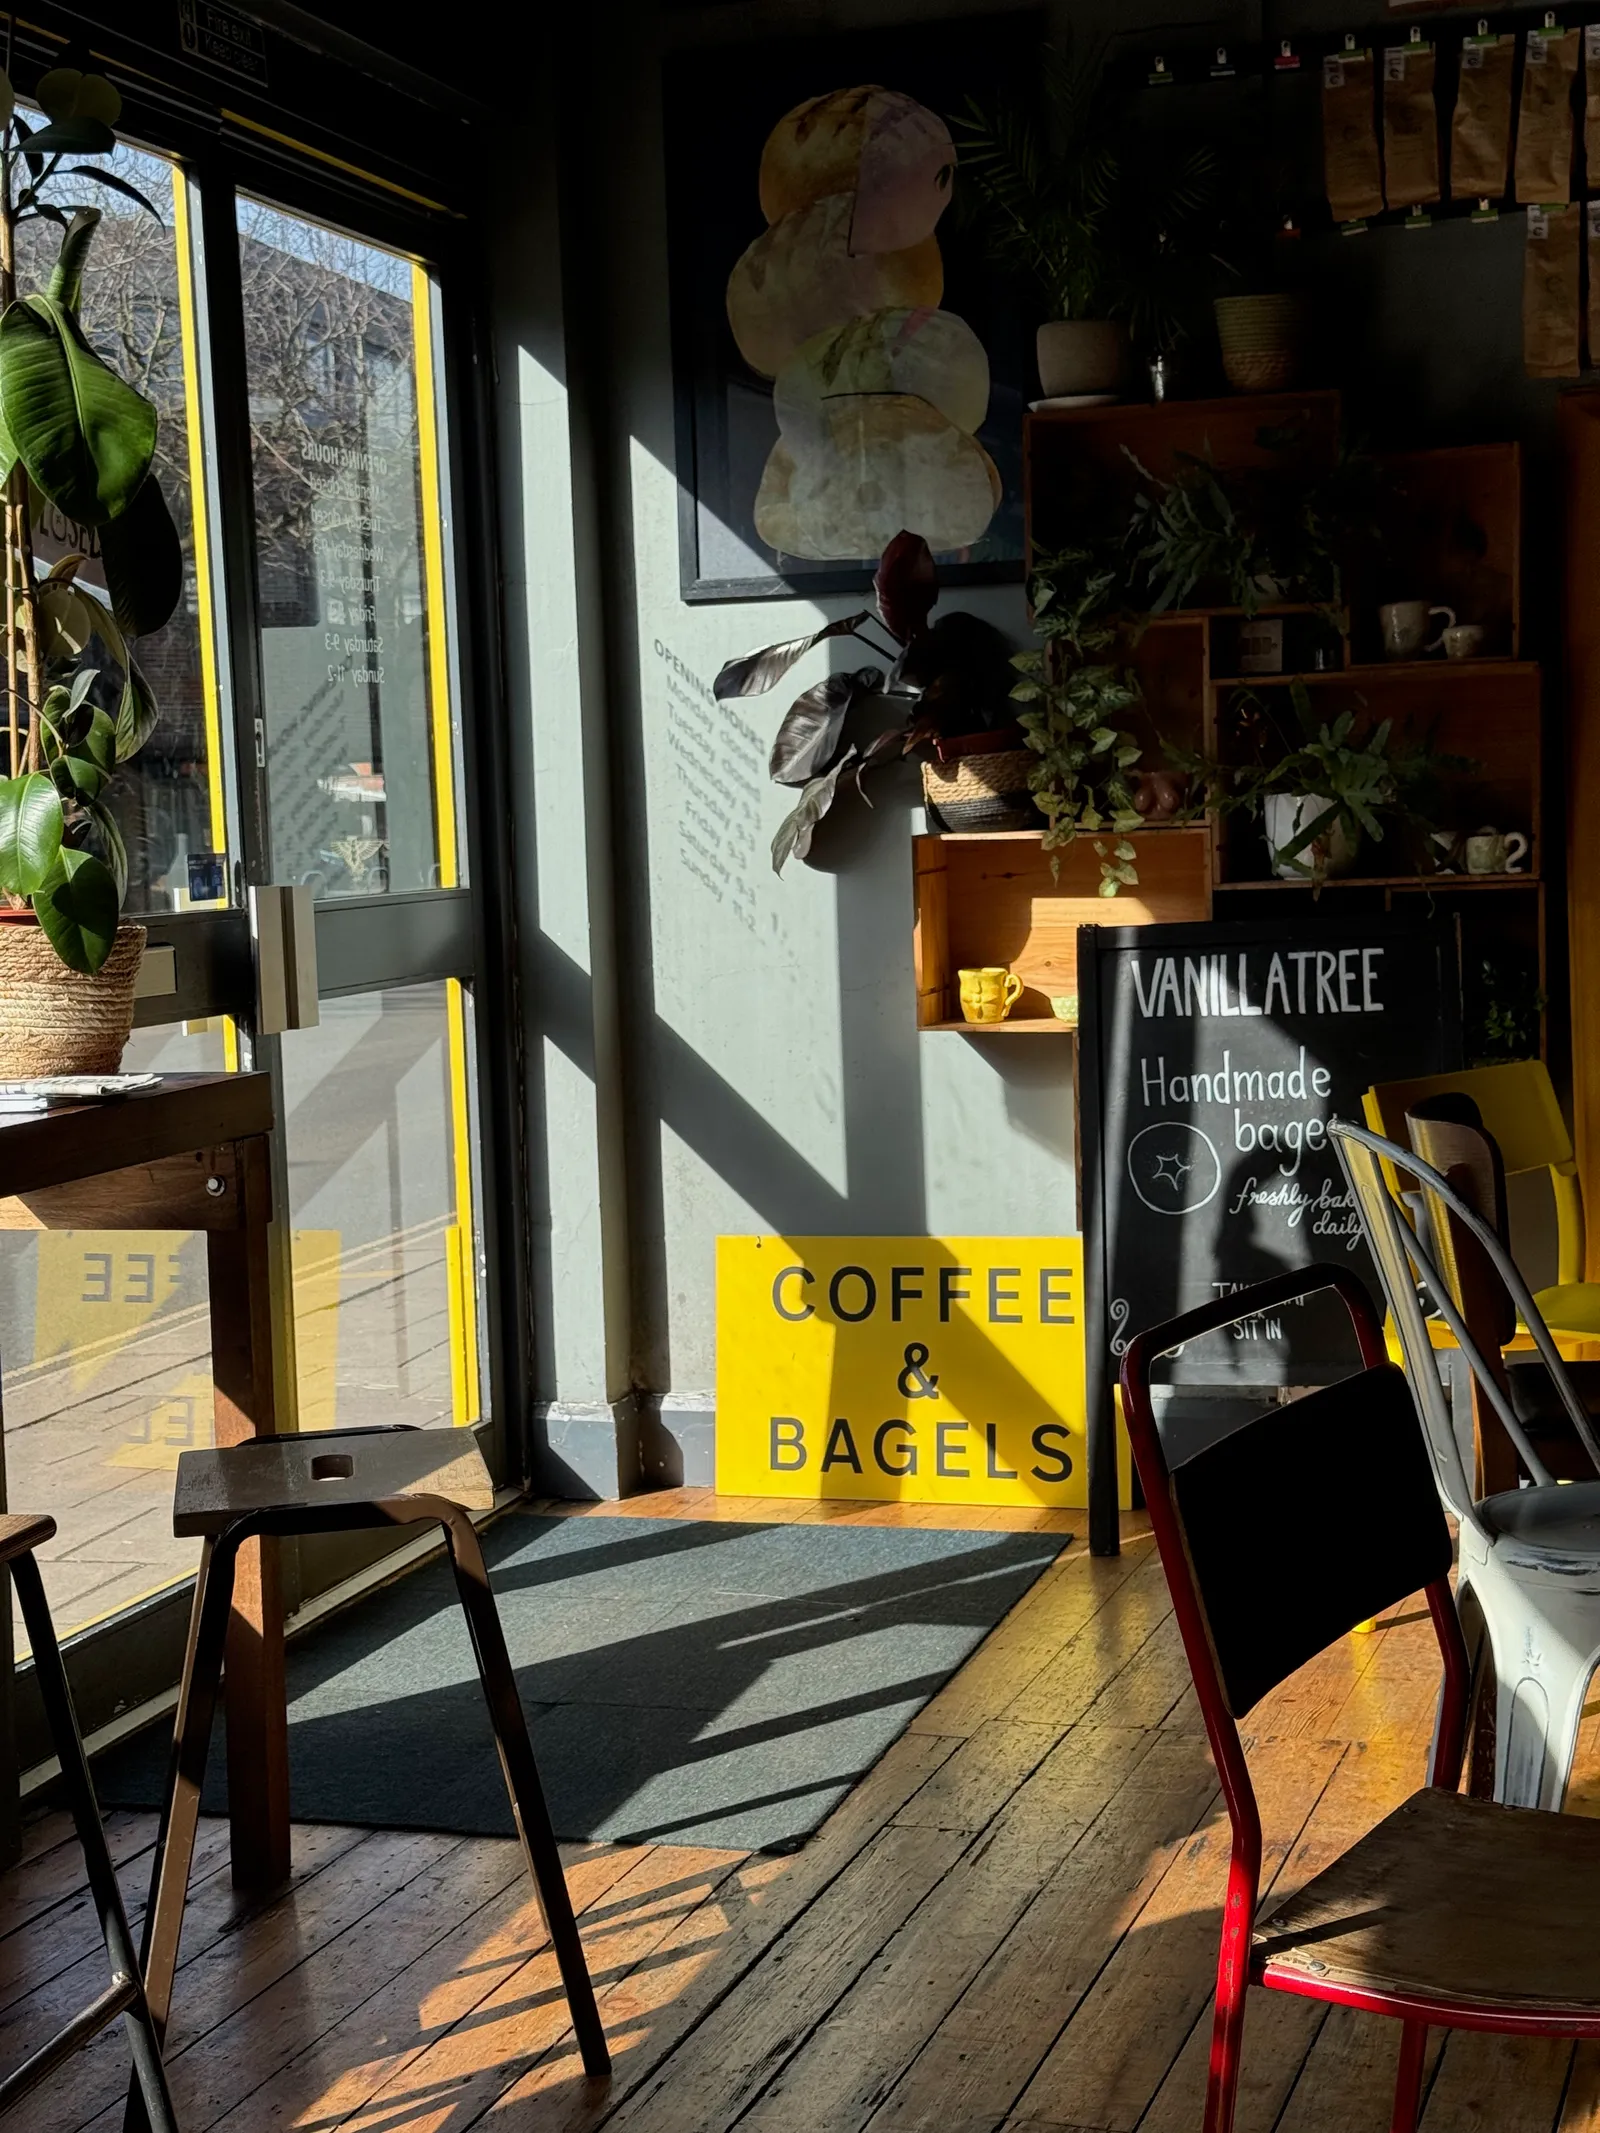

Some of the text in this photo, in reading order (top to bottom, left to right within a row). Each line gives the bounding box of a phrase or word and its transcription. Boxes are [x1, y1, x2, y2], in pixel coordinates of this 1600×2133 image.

[204, 33, 231, 60] Keep
[206, 8, 252, 47] Fire exit
[654, 638, 766, 756] OPENING HOURS
[1141, 1045, 1331, 1106] Handmade
[1234, 1108, 1328, 1176] bage
[1229, 1177, 1357, 1228] freshly bak
[1312, 1212, 1365, 1251] daily
[771, 1265, 1075, 1324] COFFEE
[1232, 1317, 1283, 1341] SIT IN
[896, 1341, 940, 1401] &
[769, 1416, 1073, 1484] BAGELS
